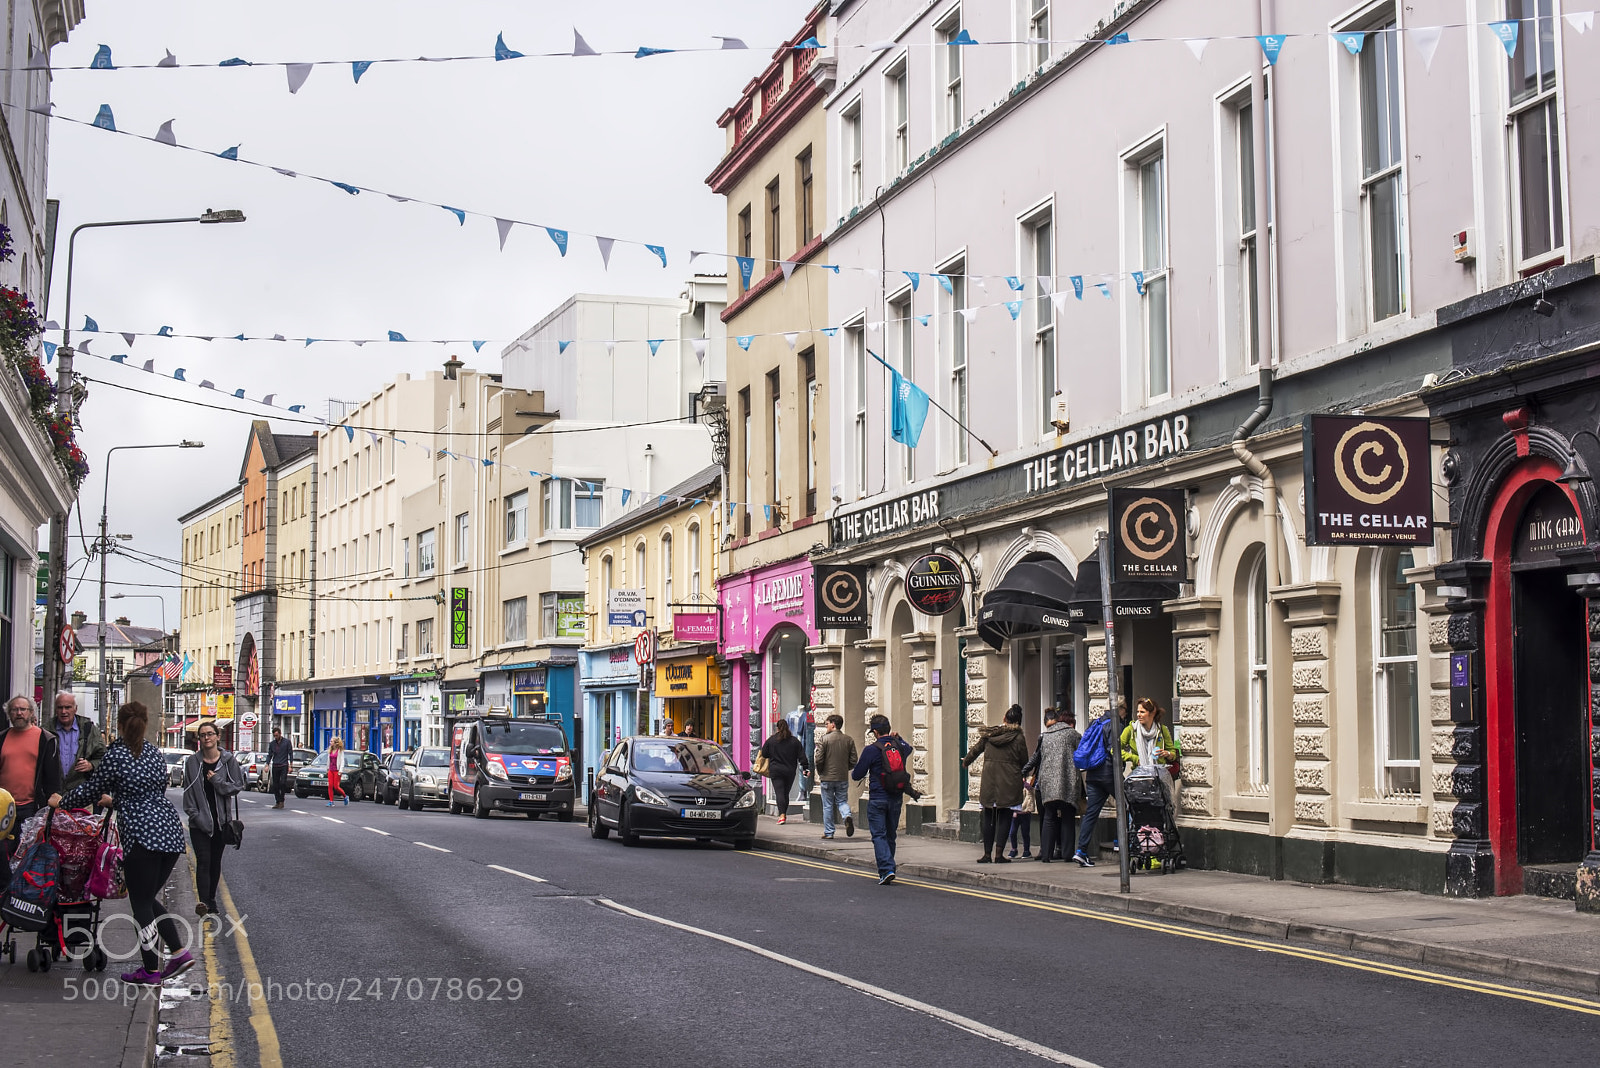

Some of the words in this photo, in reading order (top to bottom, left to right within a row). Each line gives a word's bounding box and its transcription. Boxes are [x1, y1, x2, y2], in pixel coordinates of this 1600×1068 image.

[1023, 454, 1058, 494] THE
[1063, 430, 1138, 482] CELLAR
[1145, 414, 1190, 460] BAR
[841, 513, 862, 541] THE
[864, 499, 910, 537] CELLAR
[912, 490, 940, 523] BAR
[1319, 512, 1353, 527] THE
[1360, 514, 1428, 528] CELLAR
[1529, 519, 1552, 541] MING
[1555, 516, 1582, 538] GARD
[1122, 564, 1140, 572] THE
[1143, 564, 1178, 572] CELLAR
[772, 574, 804, 602] FEMME
[910, 574, 961, 588] GUINNESS
[454, 588, 466, 645] SAVOY
[1116, 605, 1152, 616] GUINNESS
[1042, 614, 1069, 628] GUINNESS
[10, 896, 37, 914] PUMA
